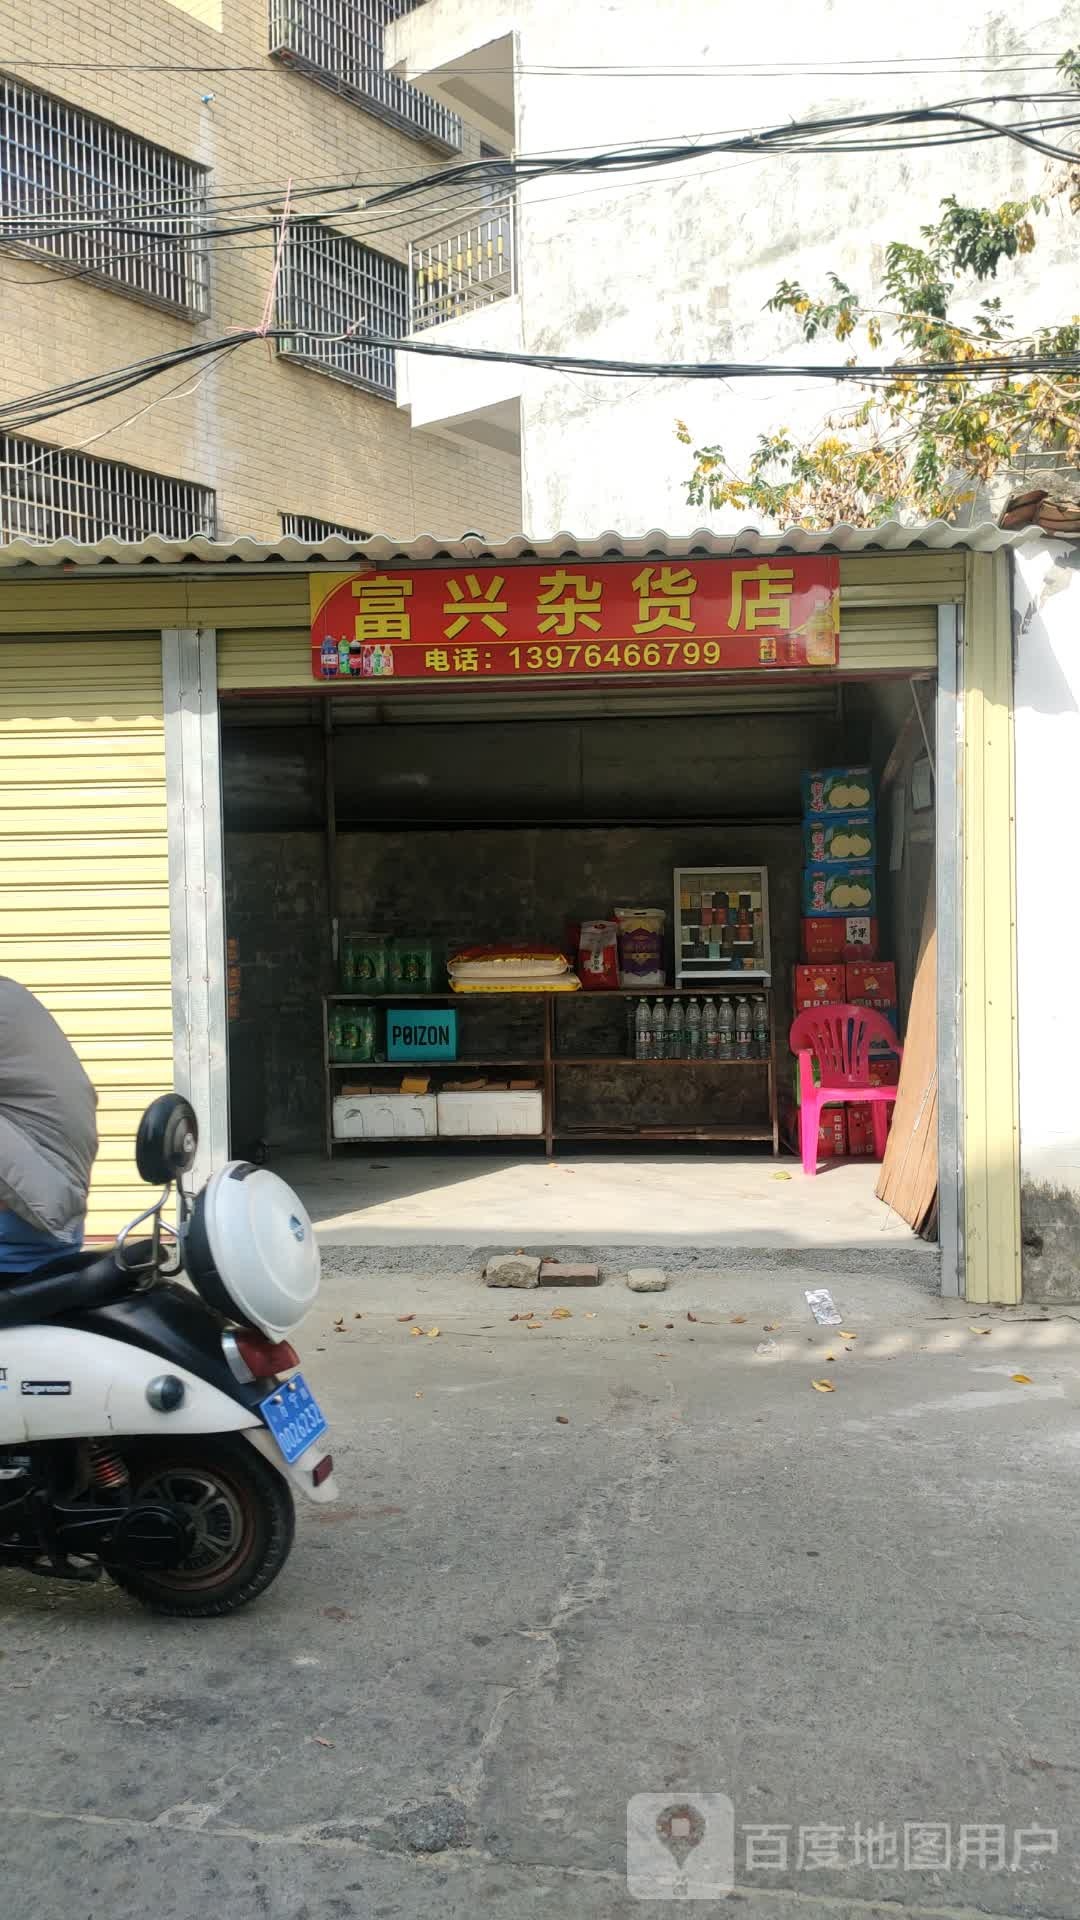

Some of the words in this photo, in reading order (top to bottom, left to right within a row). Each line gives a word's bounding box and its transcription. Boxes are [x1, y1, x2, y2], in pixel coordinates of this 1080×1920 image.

[351, 564, 796, 641] 富兴杂货店
